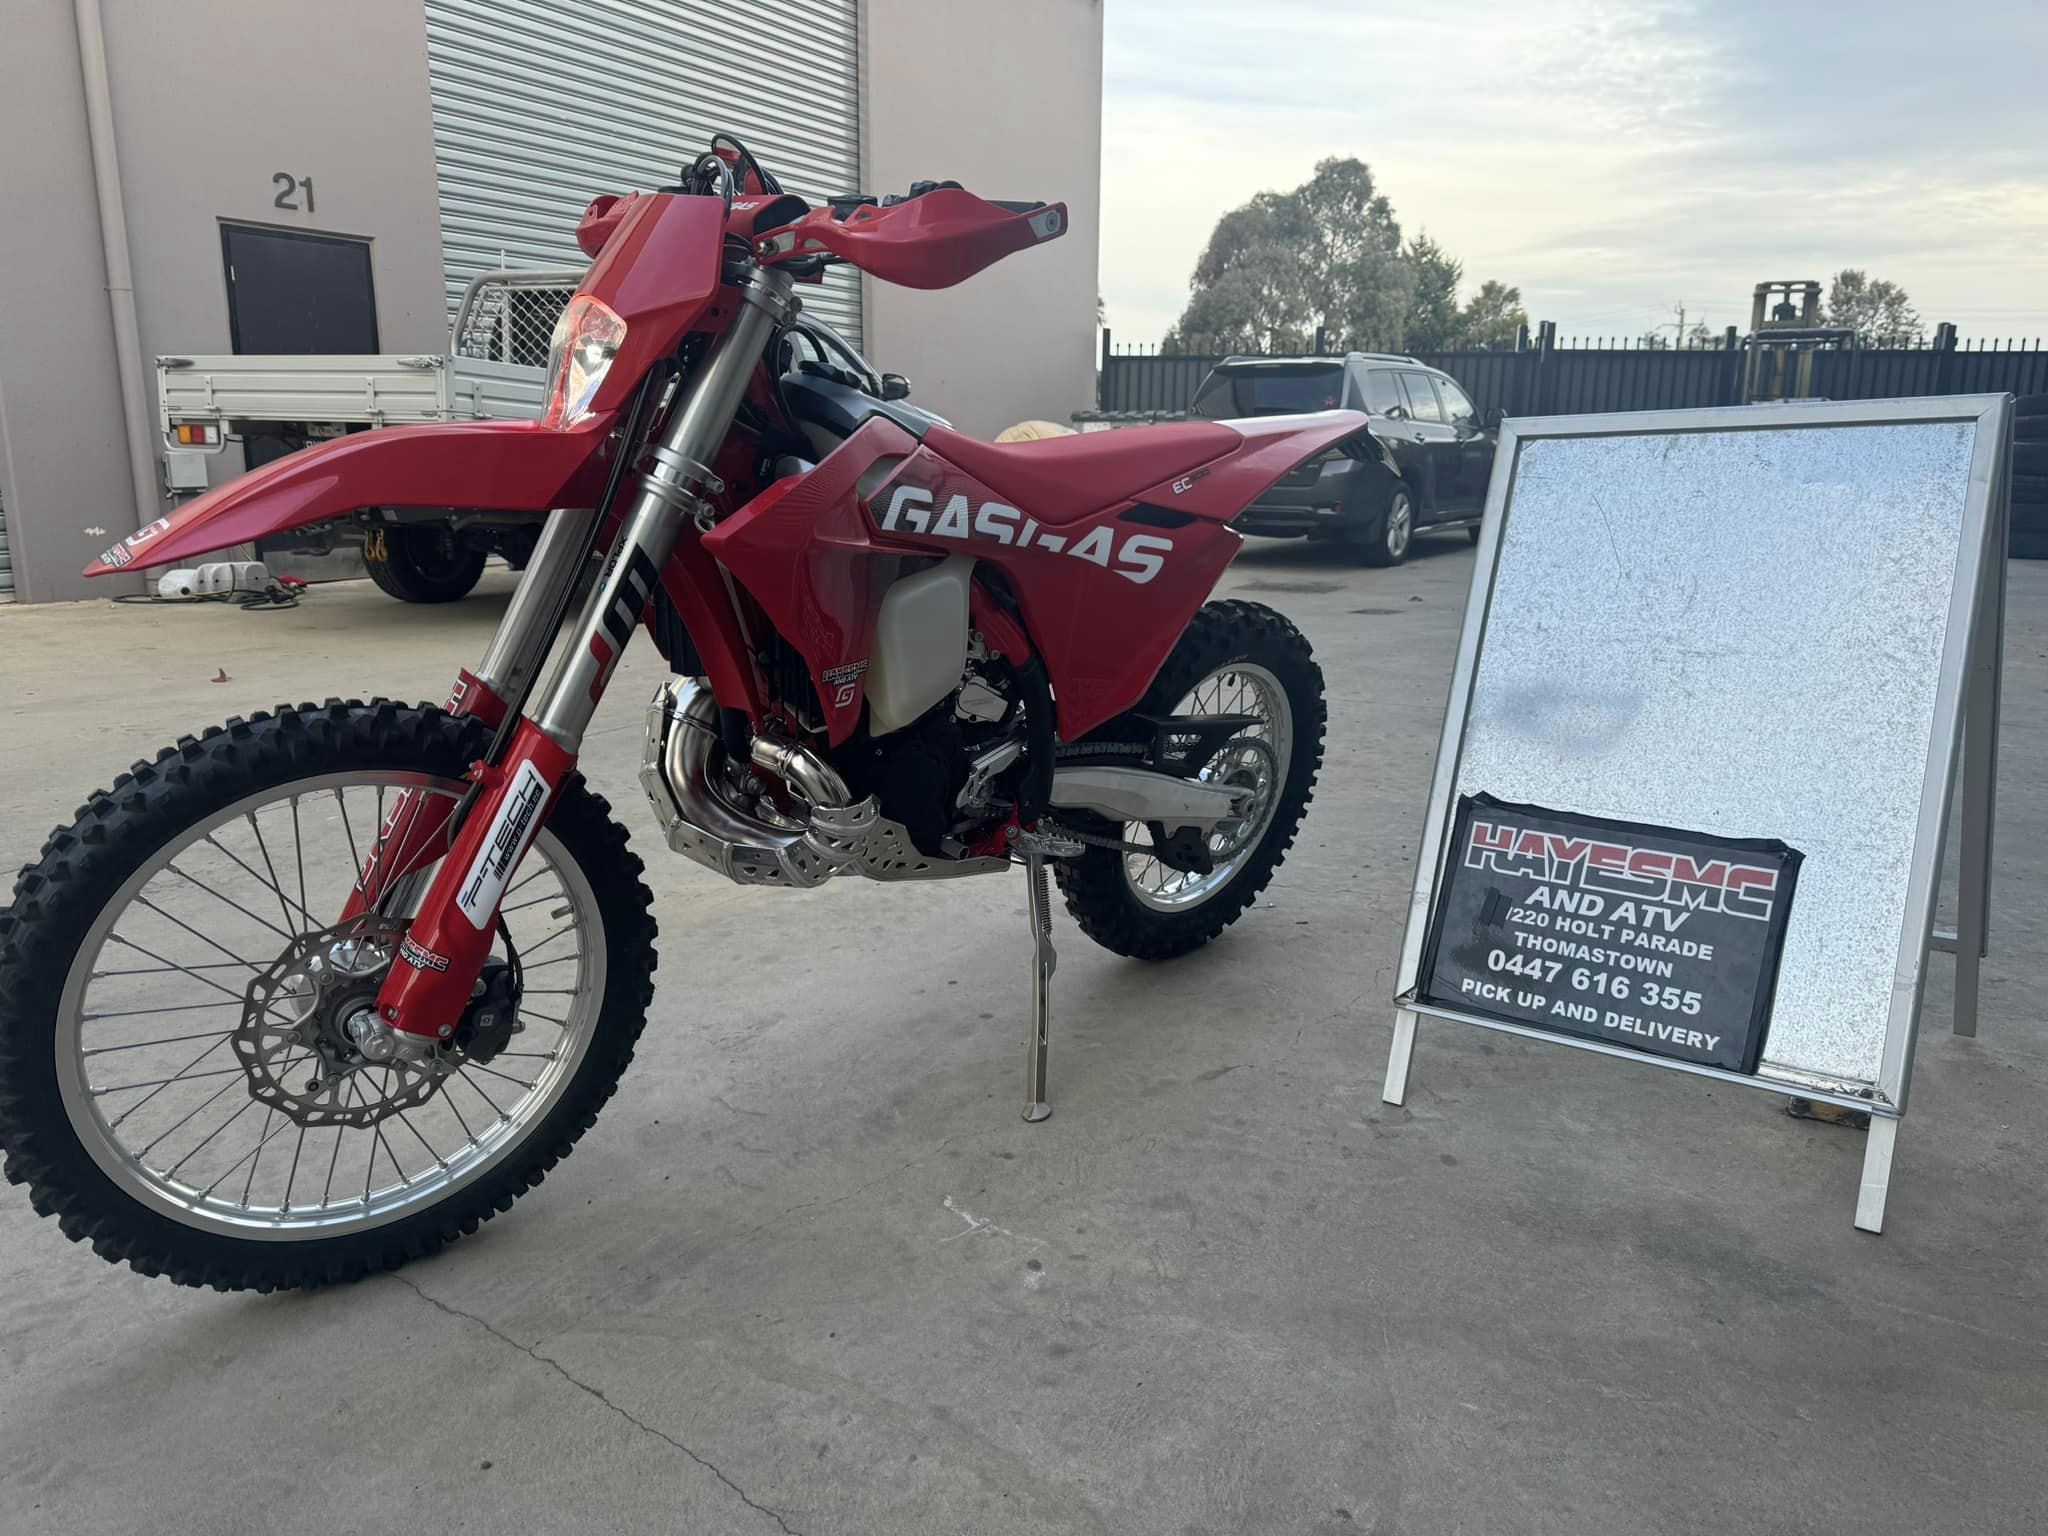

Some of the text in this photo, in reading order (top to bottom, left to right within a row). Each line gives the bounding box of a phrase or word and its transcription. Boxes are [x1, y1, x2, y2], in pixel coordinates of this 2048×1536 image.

[272, 171, 315, 213] 21
[1172, 477, 1193, 494] EC
[604, 535, 628, 579] XPLOR
[461, 770, 537, 908] P-TECH
[1464, 821, 1779, 922] HAYESMC
[1524, 885, 1691, 933] AND ATV
[1514, 931, 1673, 978] THOMASTOWN
[1555, 916, 1615, 940] HOLT
[1620, 928, 1714, 961] PARADE
[1487, 949, 1703, 1016] 0447 616 355
[1461, 978, 1721, 1052] PICK UP AND DELIVERY
